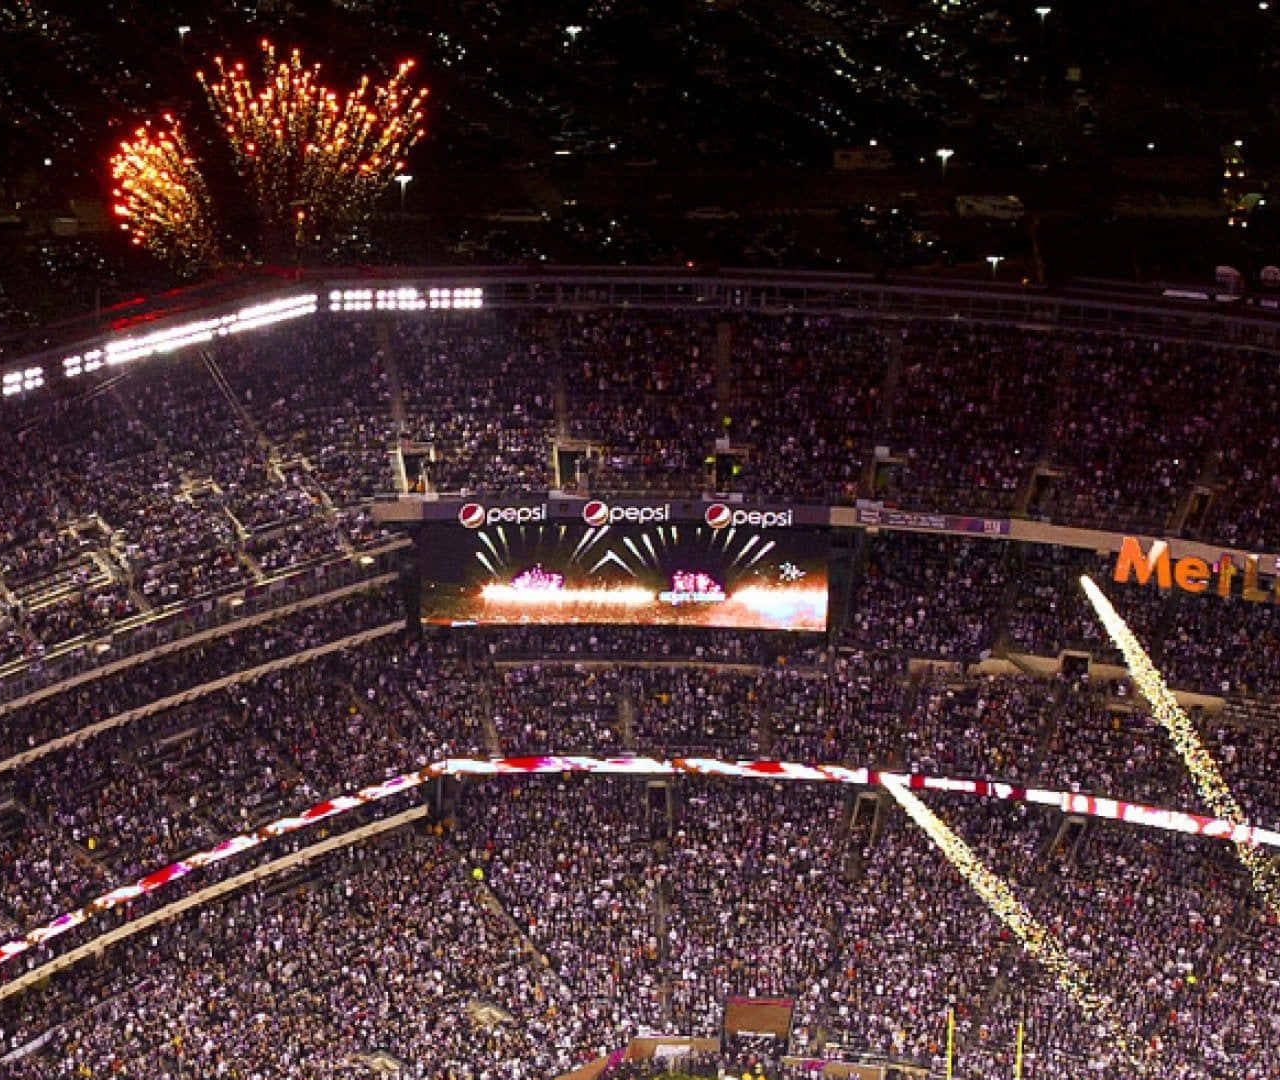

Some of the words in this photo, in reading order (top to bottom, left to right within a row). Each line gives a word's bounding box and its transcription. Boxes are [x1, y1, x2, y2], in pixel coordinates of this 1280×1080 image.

[486, 503, 547, 525] pepsi
[609, 503, 670, 524] pepsi
[730, 508, 793, 528] pepsi
